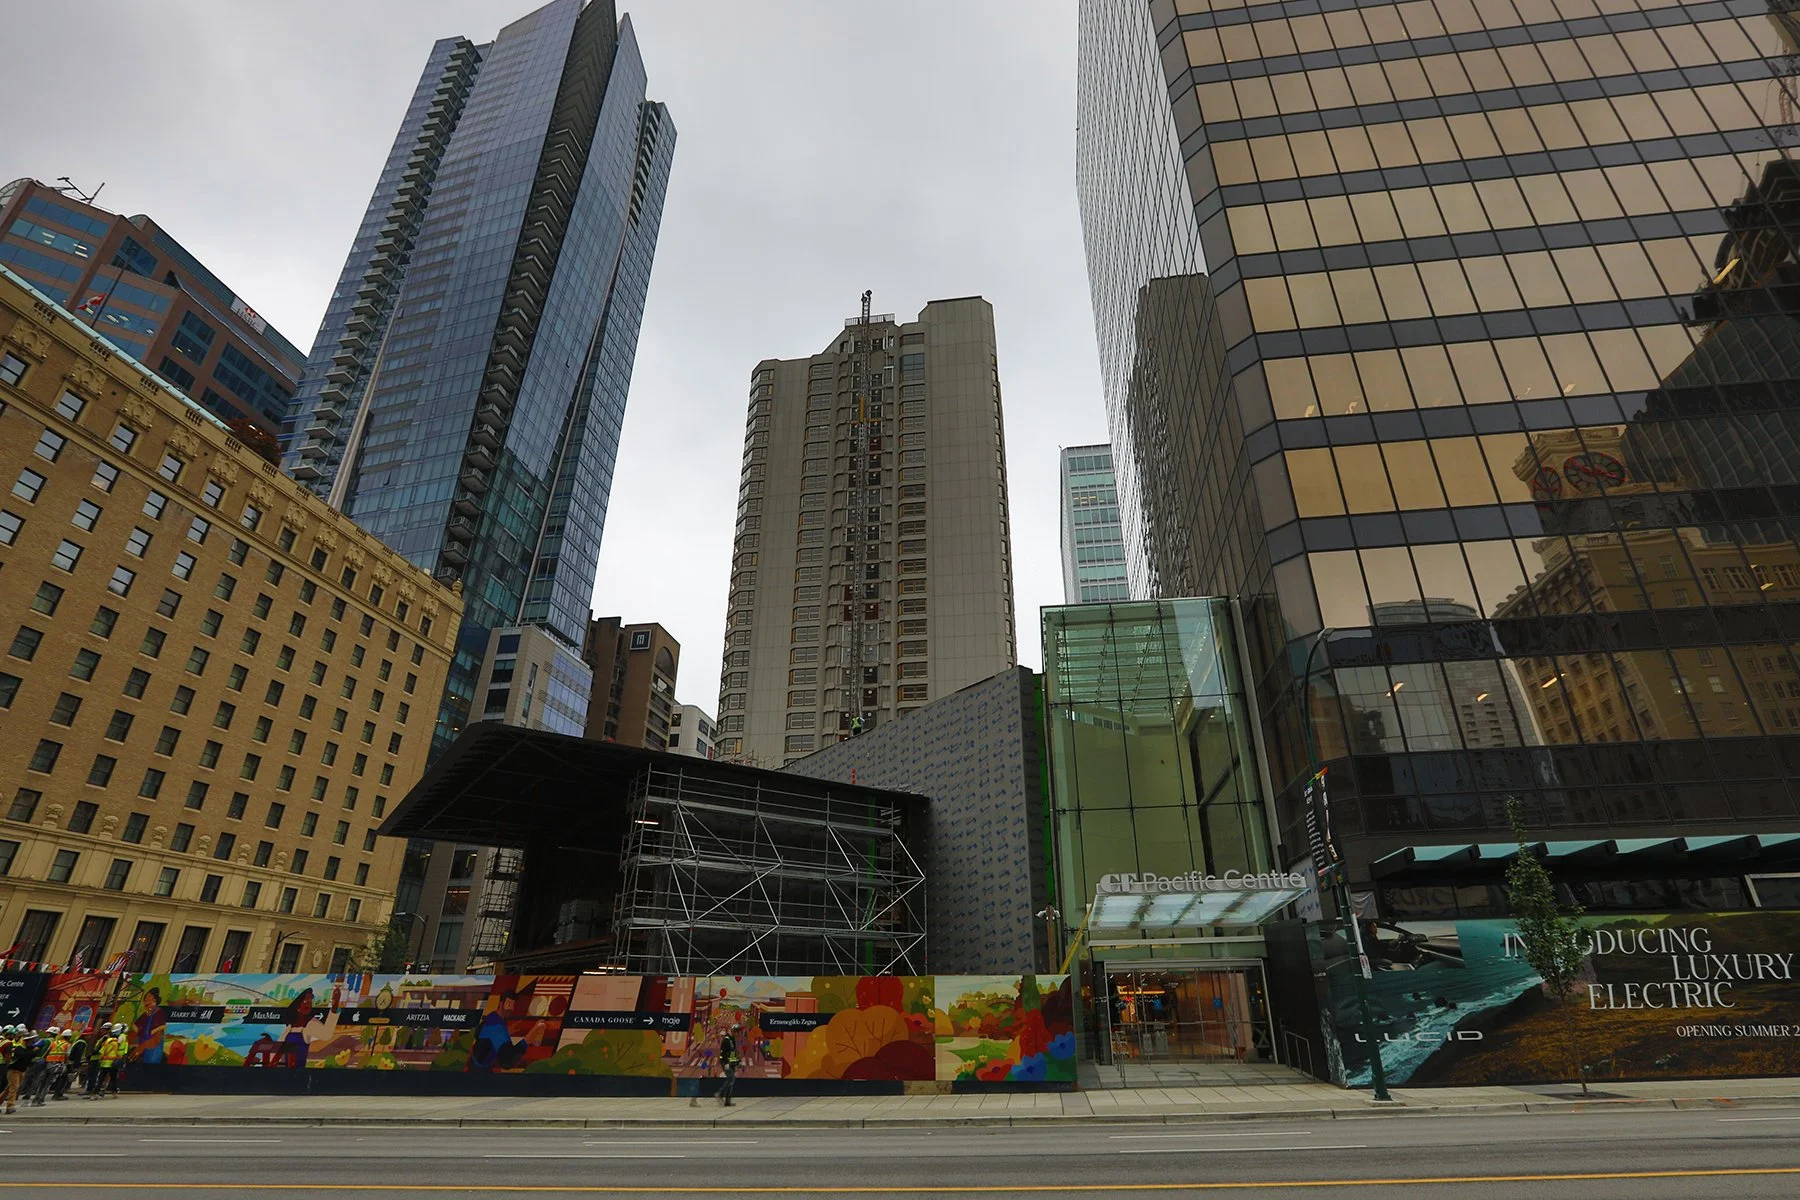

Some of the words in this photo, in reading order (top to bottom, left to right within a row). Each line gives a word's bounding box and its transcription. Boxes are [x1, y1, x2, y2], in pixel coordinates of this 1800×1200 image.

[1100, 873, 1137, 893] CF
[1143, 871, 1216, 892] Pacific
[1224, 868, 1302, 890] Centre
[1503, 927, 1713, 959] INODUCING
[1671, 952, 1794, 982] LUXURY
[7, 980, 25, 988] Centre
[1588, 981, 1736, 1011] ELECTRIC
[170, 1010, 190, 1018] HARRY
[200, 1009, 214, 1020] H&M
[252, 1011, 281, 1020] MaxMara
[405, 1014, 430, 1022] ARITZIA
[442, 1014, 467, 1022] MACKAGE
[574, 1016, 605, 1024] CANADA
[608, 1016, 635, 1025] GOOSE
[662, 1016, 681, 1026] maje
[801, 1018, 817, 1026] Zegna
[1676, 1025, 1732, 1038] OPENING
[1735, 1024, 1791, 1038] SUMMER
